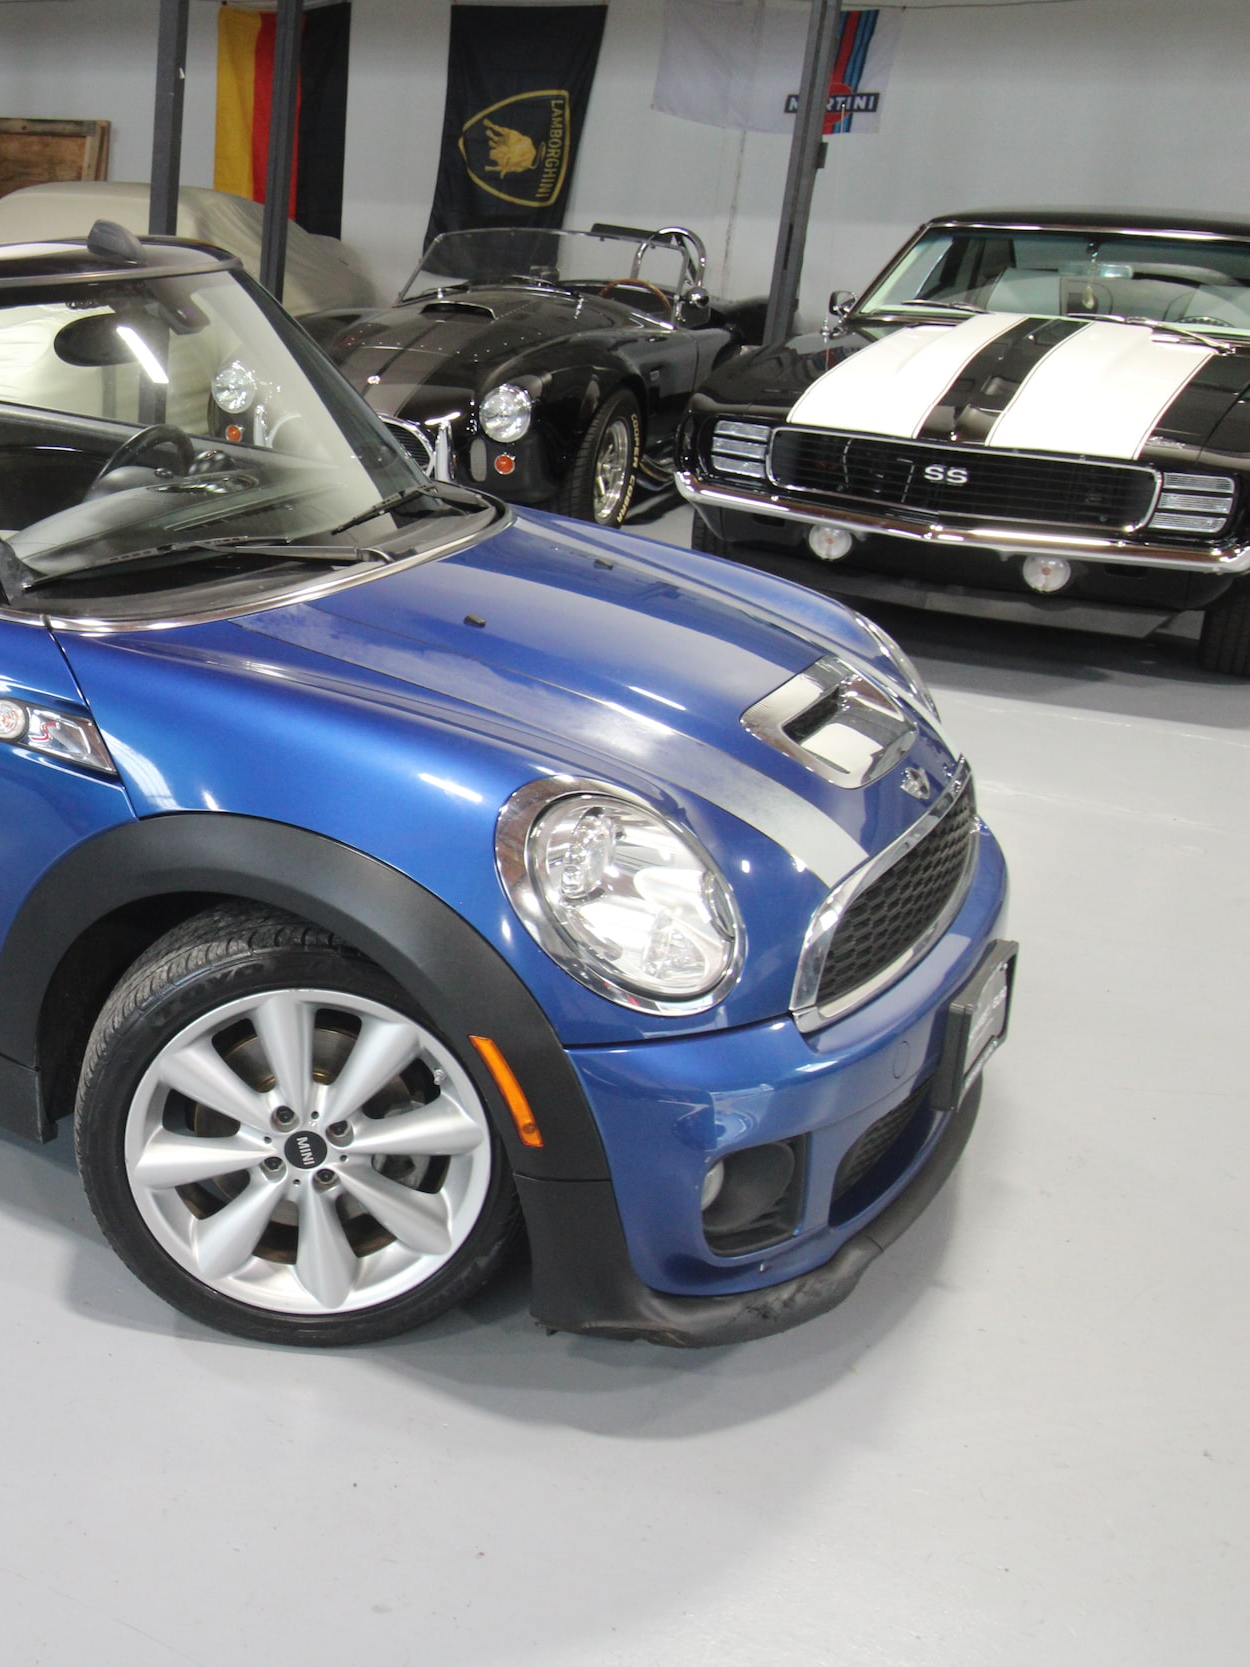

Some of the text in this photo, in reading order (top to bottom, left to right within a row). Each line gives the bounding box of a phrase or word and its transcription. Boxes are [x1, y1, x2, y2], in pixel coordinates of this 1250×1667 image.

[788, 94, 876, 112] MRTINI
[535, 100, 564, 198] LAMBORGHINI
[924, 464, 969, 485] SS
[29, 721, 60, 742] S
[296, 1136, 316, 1166] MINI
